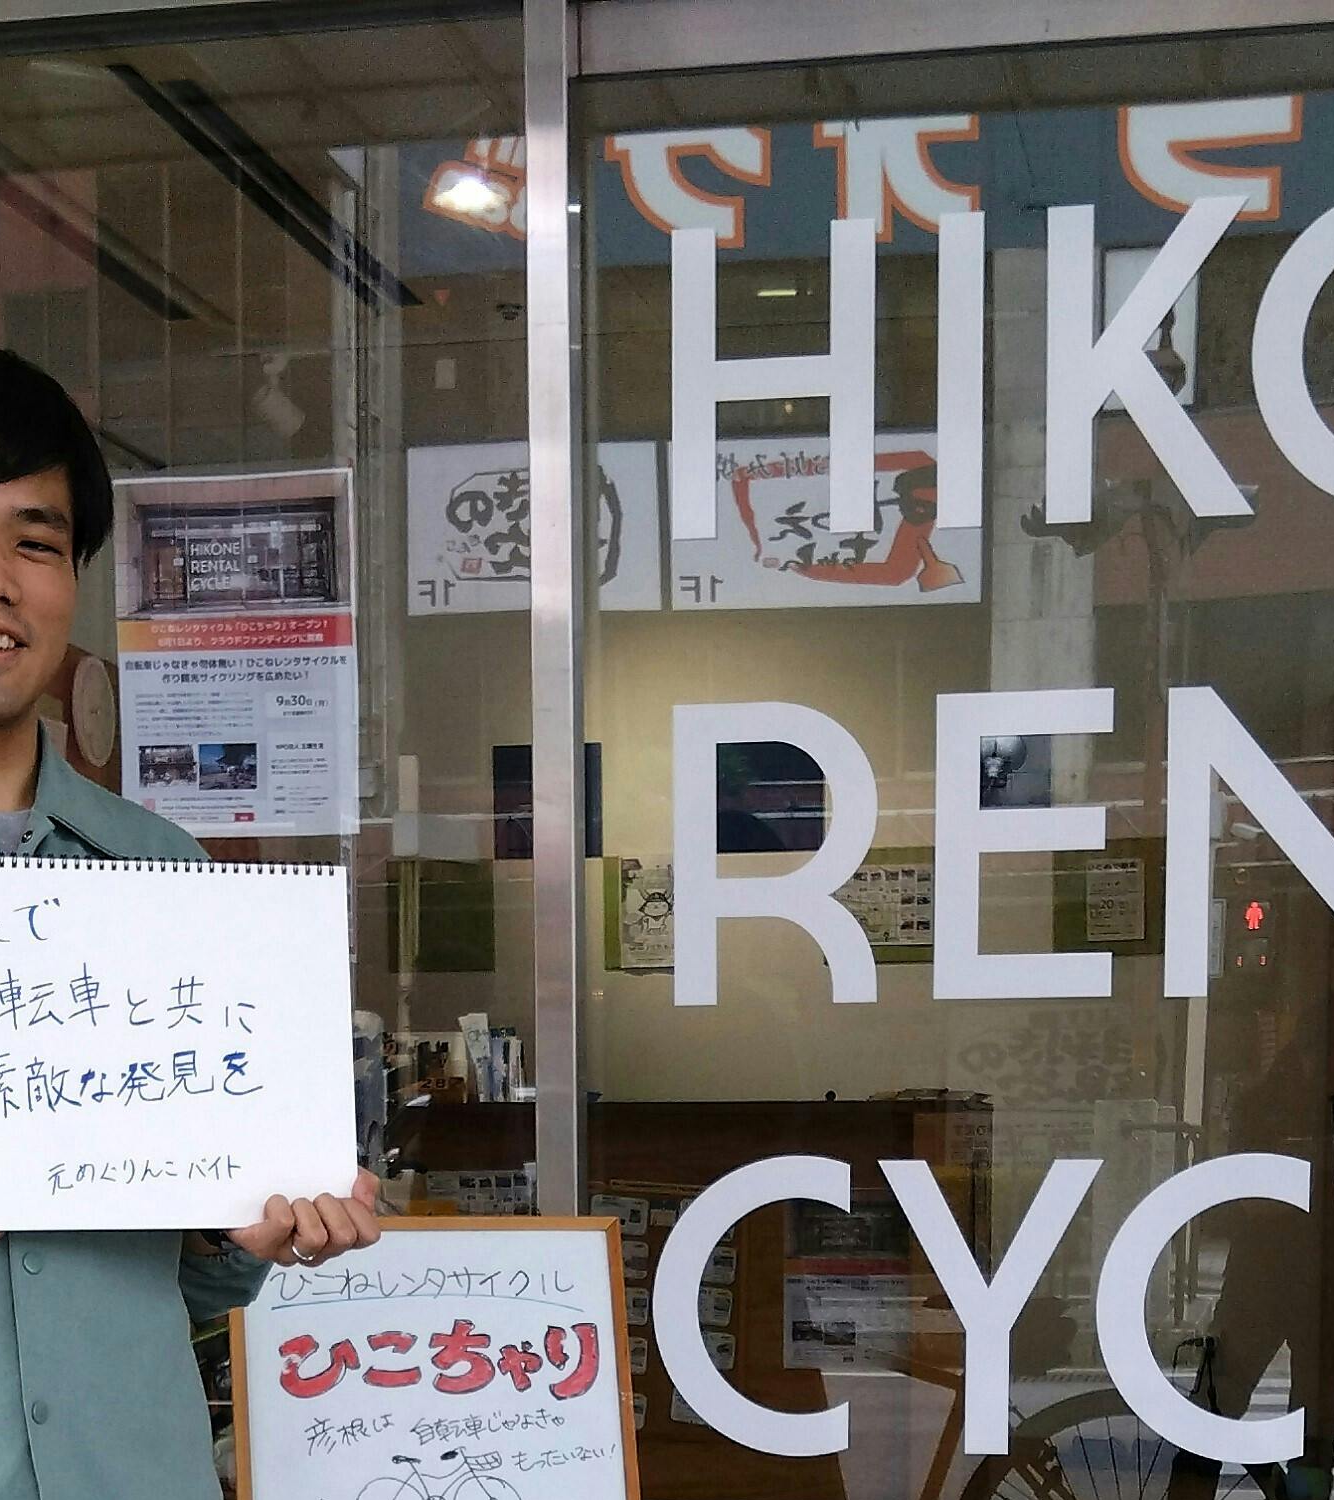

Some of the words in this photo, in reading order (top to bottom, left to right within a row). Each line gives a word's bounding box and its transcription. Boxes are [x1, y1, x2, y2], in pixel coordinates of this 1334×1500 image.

[190, 541, 240, 556] HIKONE
[190, 558, 241, 574] RENTAL
[190, 574, 231, 592] CYCLE
[269, 1266, 574, 1302] ひこねレンタサイクル
[278, 1318, 599, 1400] ひこちゃり
